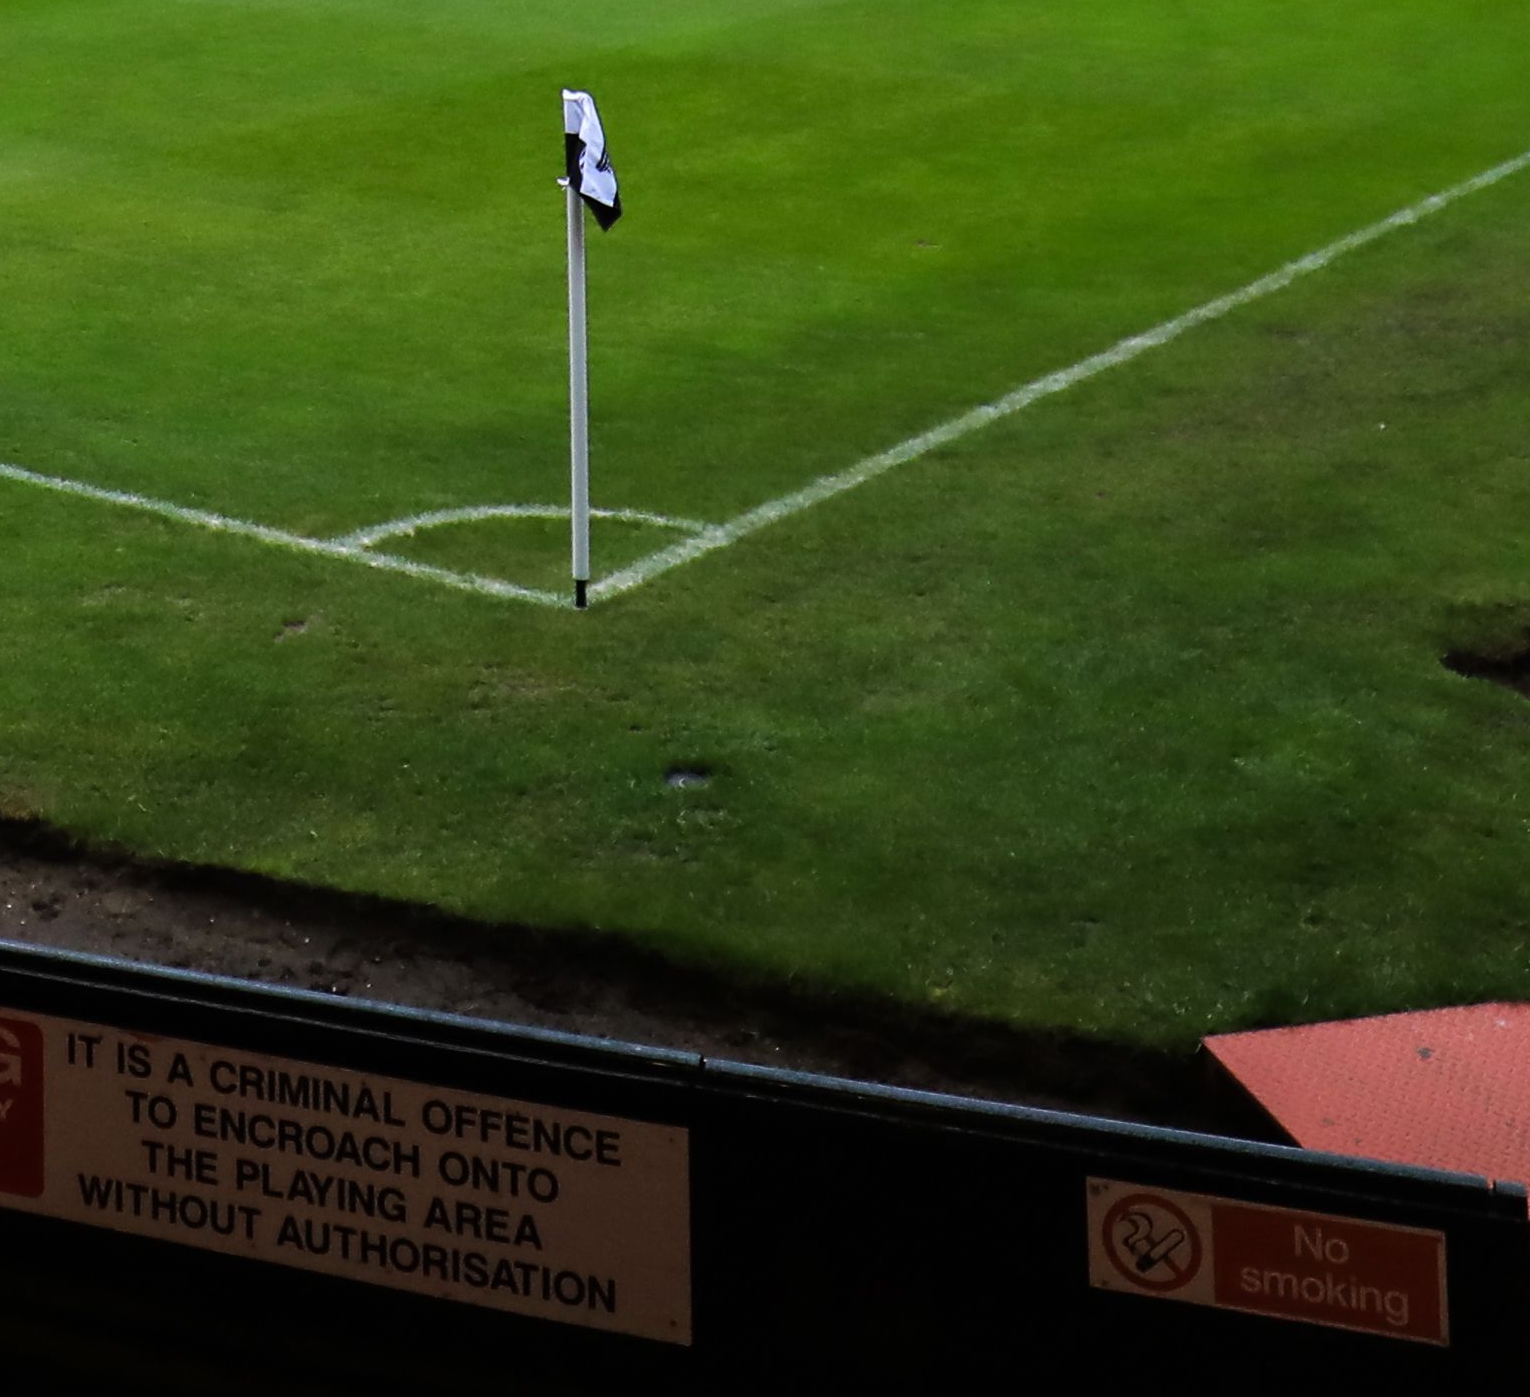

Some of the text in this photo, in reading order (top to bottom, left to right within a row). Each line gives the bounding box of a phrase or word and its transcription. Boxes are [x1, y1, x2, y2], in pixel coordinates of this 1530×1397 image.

[68, 1033, 622, 1167] IT IS A CRIMINAL OFFENCE
[125, 1090, 559, 1204] TO ENCROACH ONTO
[77, 1173, 616, 1314] WITHOUT AUTHORISATION
[141, 1139, 543, 1252] THE PLAYING AREA
[1293, 1224, 1350, 1265] No
[1240, 1267, 1409, 1326] smoking
